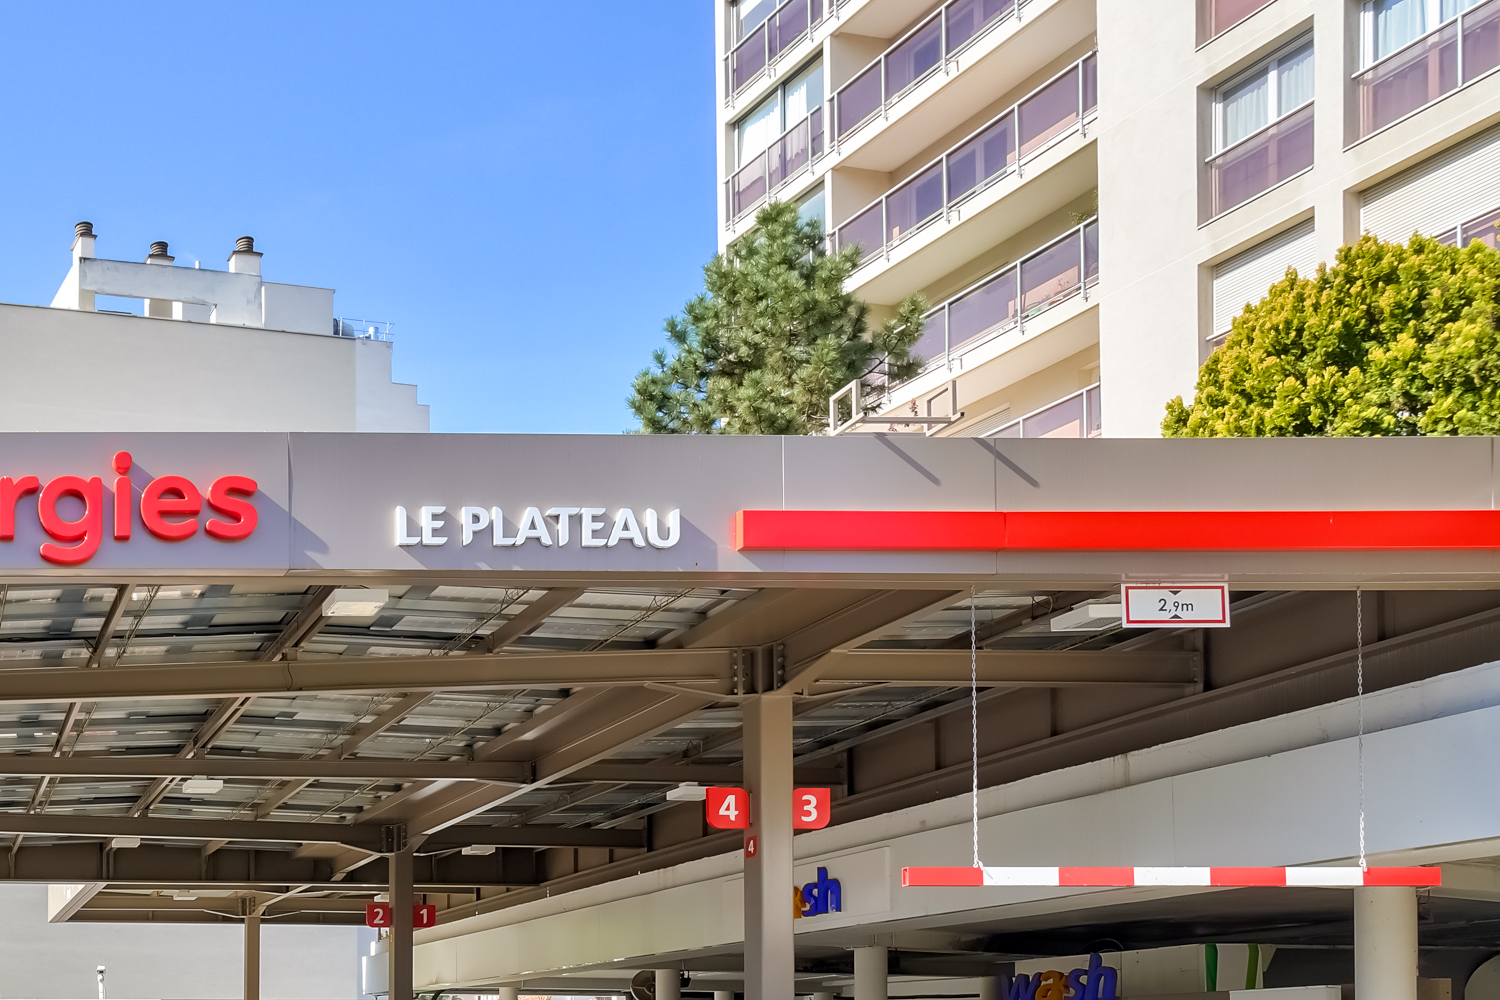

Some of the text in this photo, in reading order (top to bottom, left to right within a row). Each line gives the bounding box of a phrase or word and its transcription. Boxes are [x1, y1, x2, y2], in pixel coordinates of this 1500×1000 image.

[395, 505, 681, 549] LE PLATEAU
[1158, 598, 1194, 613] 2,9m
[718, 794, 739, 821] 4
[801, 794, 818, 822] 3
[748, 840, 754, 853] 4
[373, 908, 385, 924] 2
[419, 908, 428, 924] 1
